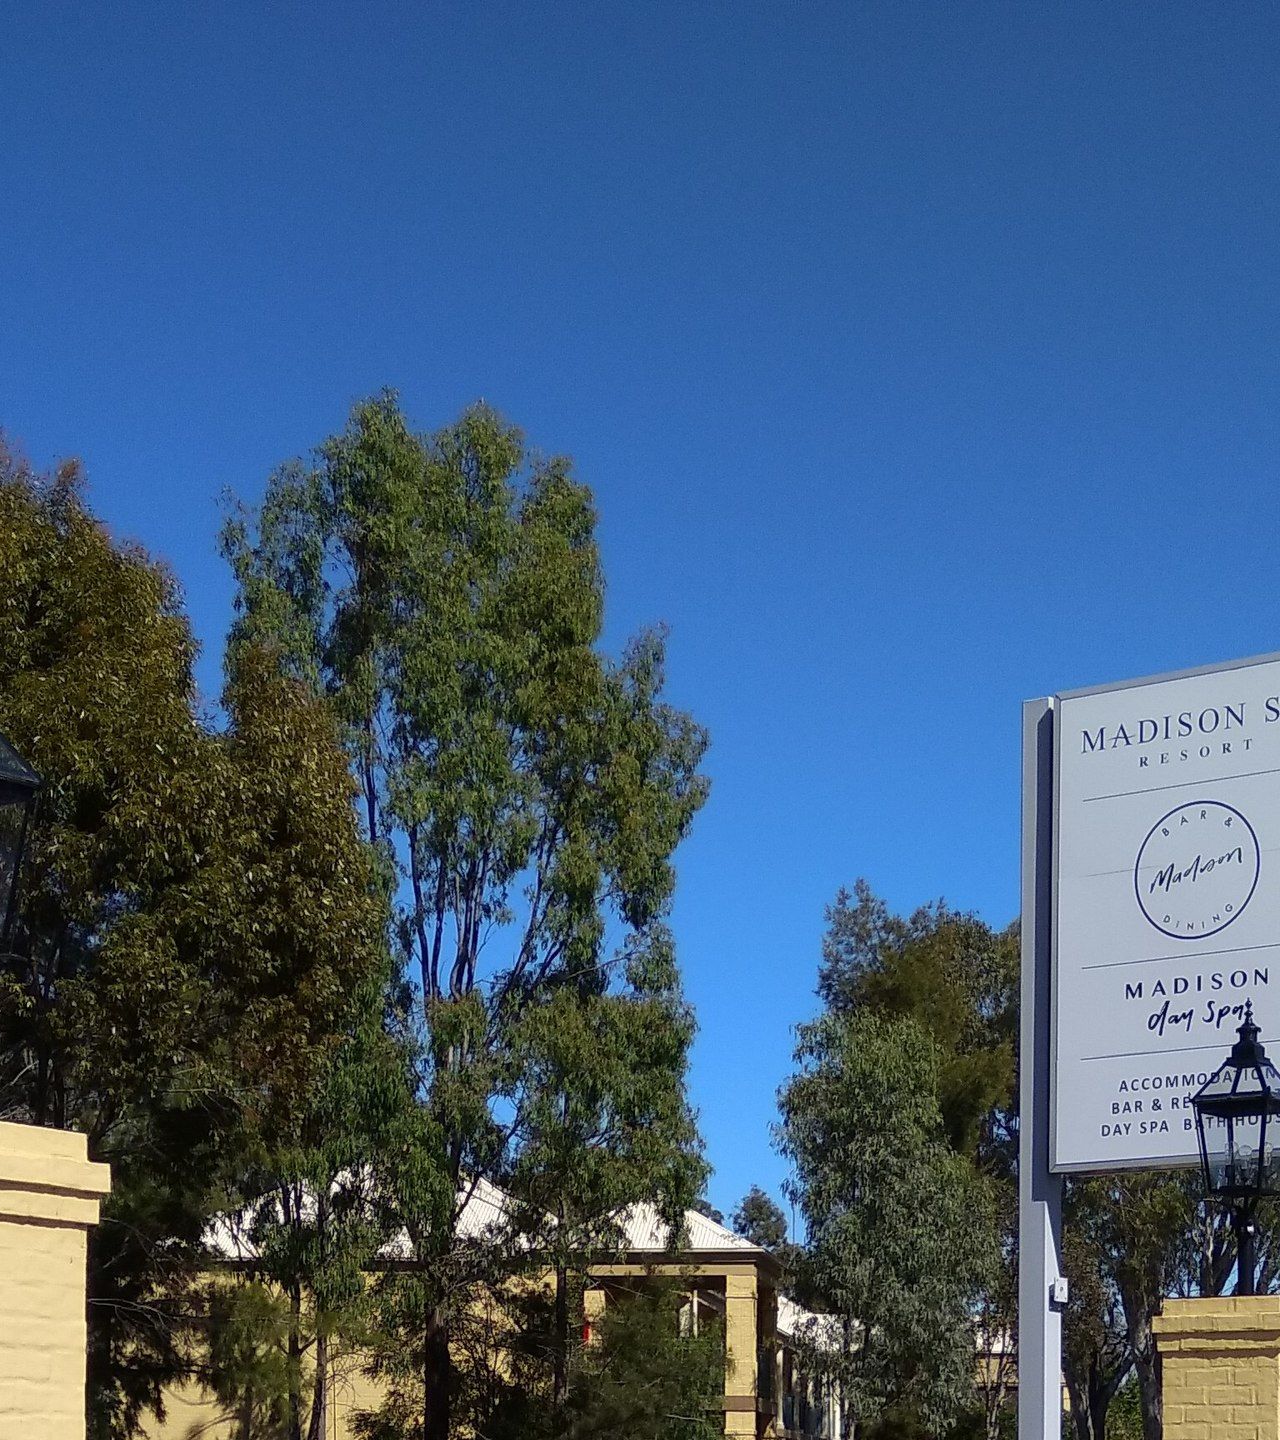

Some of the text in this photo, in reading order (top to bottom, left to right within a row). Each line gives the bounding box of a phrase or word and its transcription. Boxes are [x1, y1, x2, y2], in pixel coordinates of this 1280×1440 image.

[1080, 702, 1247, 755] MADISON
[1138, 738, 1253, 768] RESORT
[1161, 809, 1234, 838] BAR &
[1149, 846, 1243, 895] Madison
[1162, 903, 1234, 931] DINING
[1125, 967, 1270, 1000] MADISON
[1147, 1000, 1194, 1036] day
[1119, 1067, 1276, 1093] ACCOMMODAION
[1111, 1100, 1143, 1115] BAR
[1151, 1099, 1163, 1111] &
[1101, 1123, 1132, 1137] DAY
[1139, 1119, 1169, 1134] SPA
